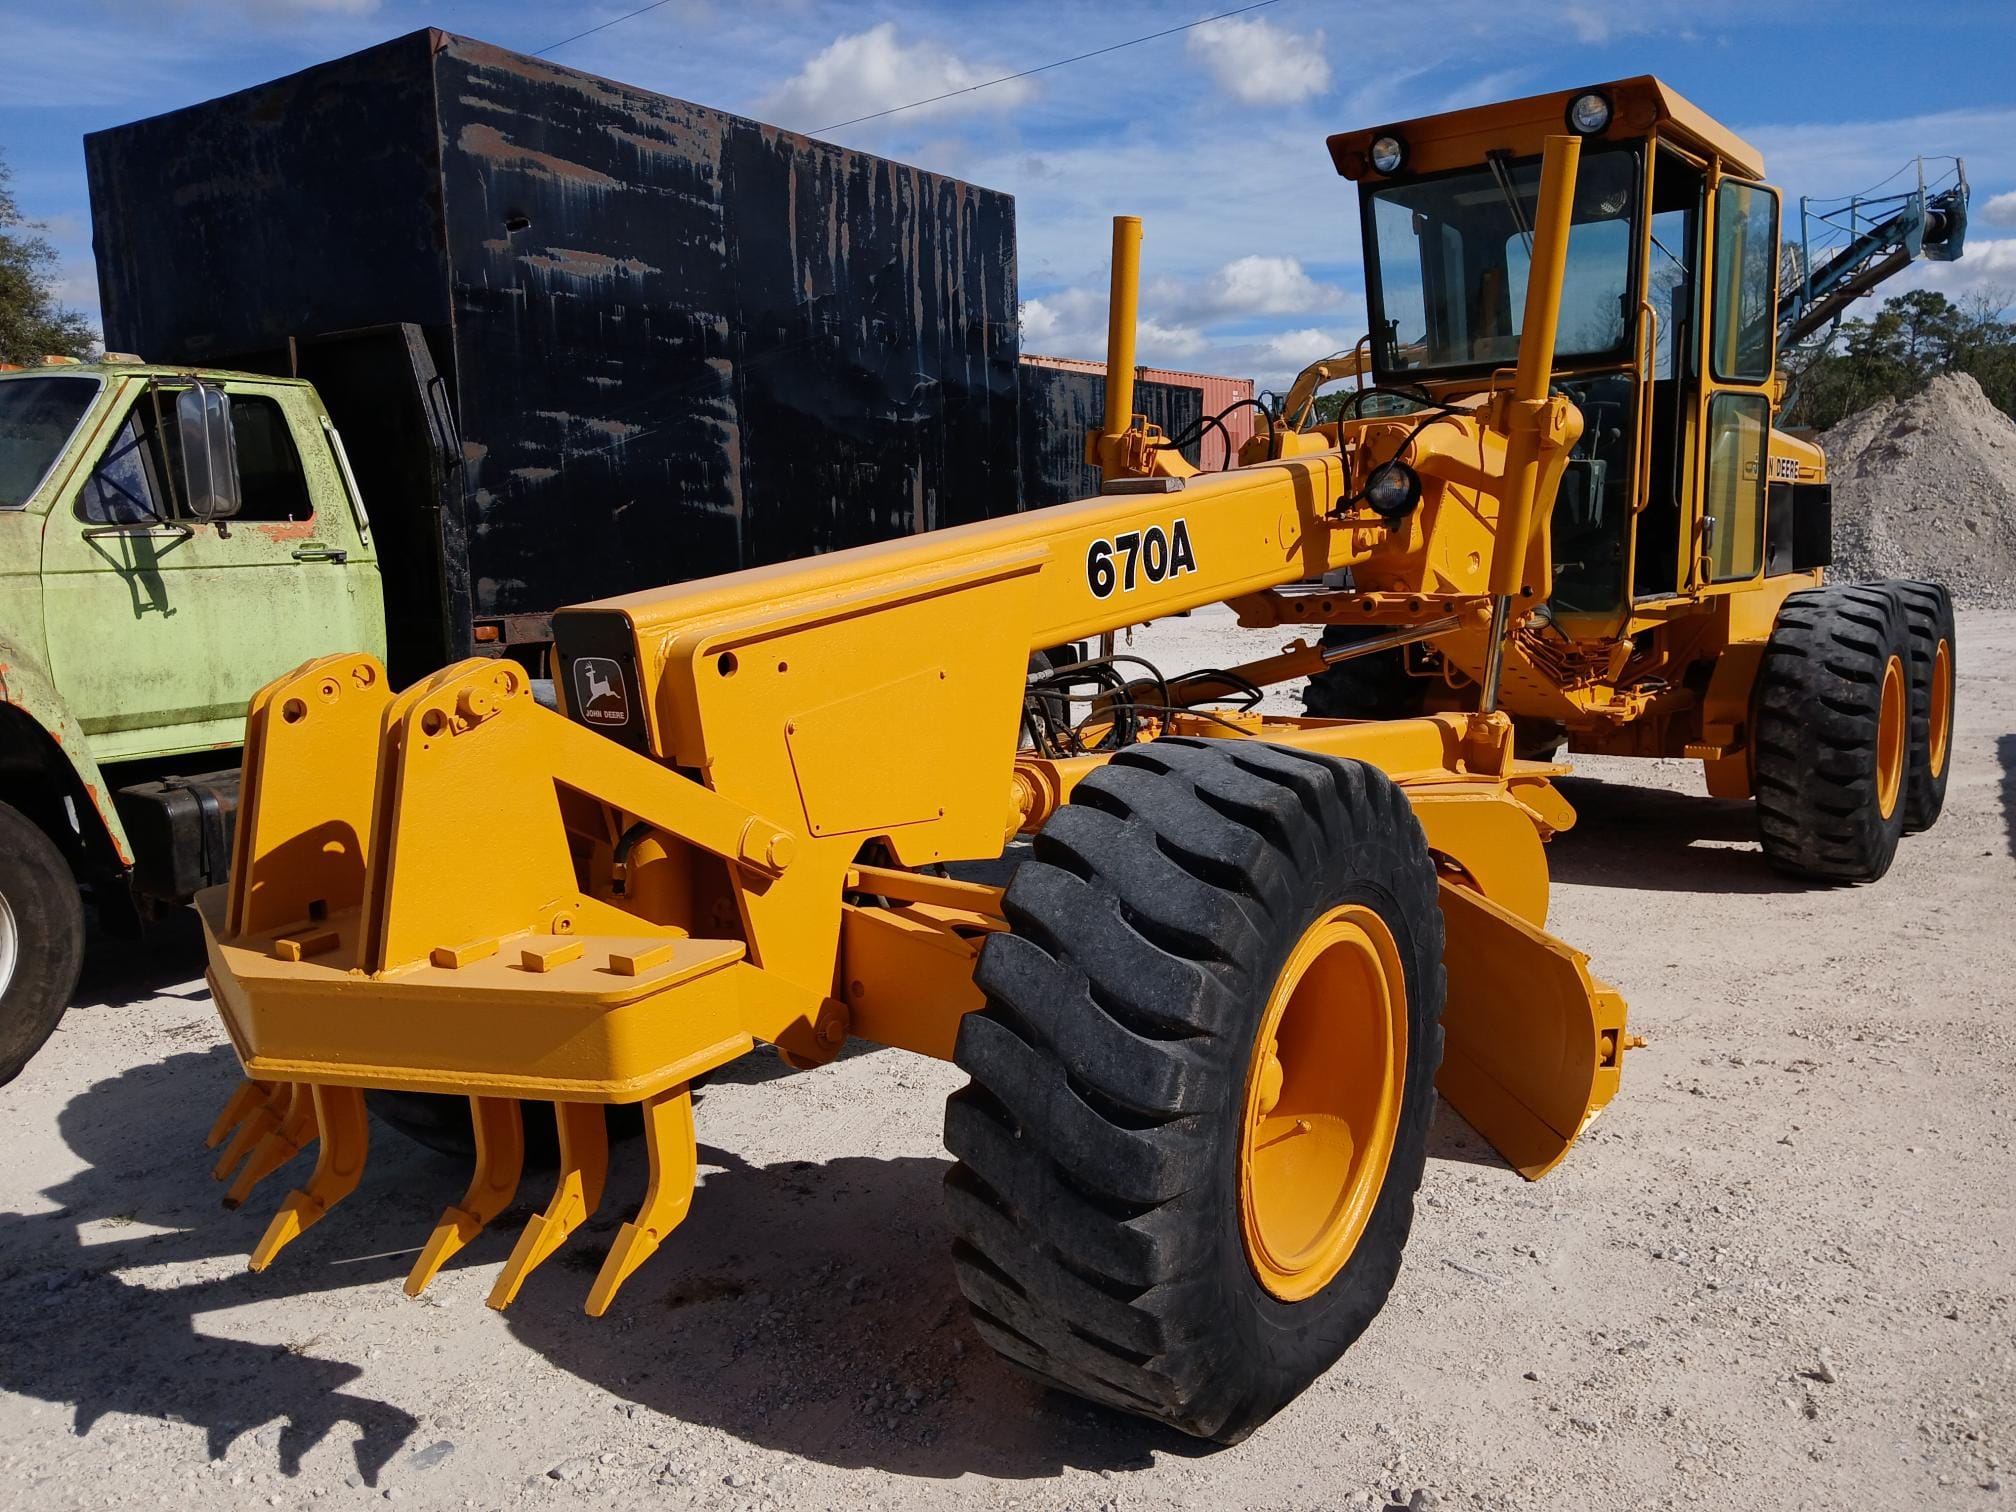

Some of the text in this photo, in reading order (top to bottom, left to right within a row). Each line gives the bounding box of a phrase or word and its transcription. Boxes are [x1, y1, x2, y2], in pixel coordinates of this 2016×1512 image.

[1776, 457, 1800, 480] DEERE
[1086, 518, 1197, 600] 670A
[586, 709, 625, 719] JOHN DEERE
